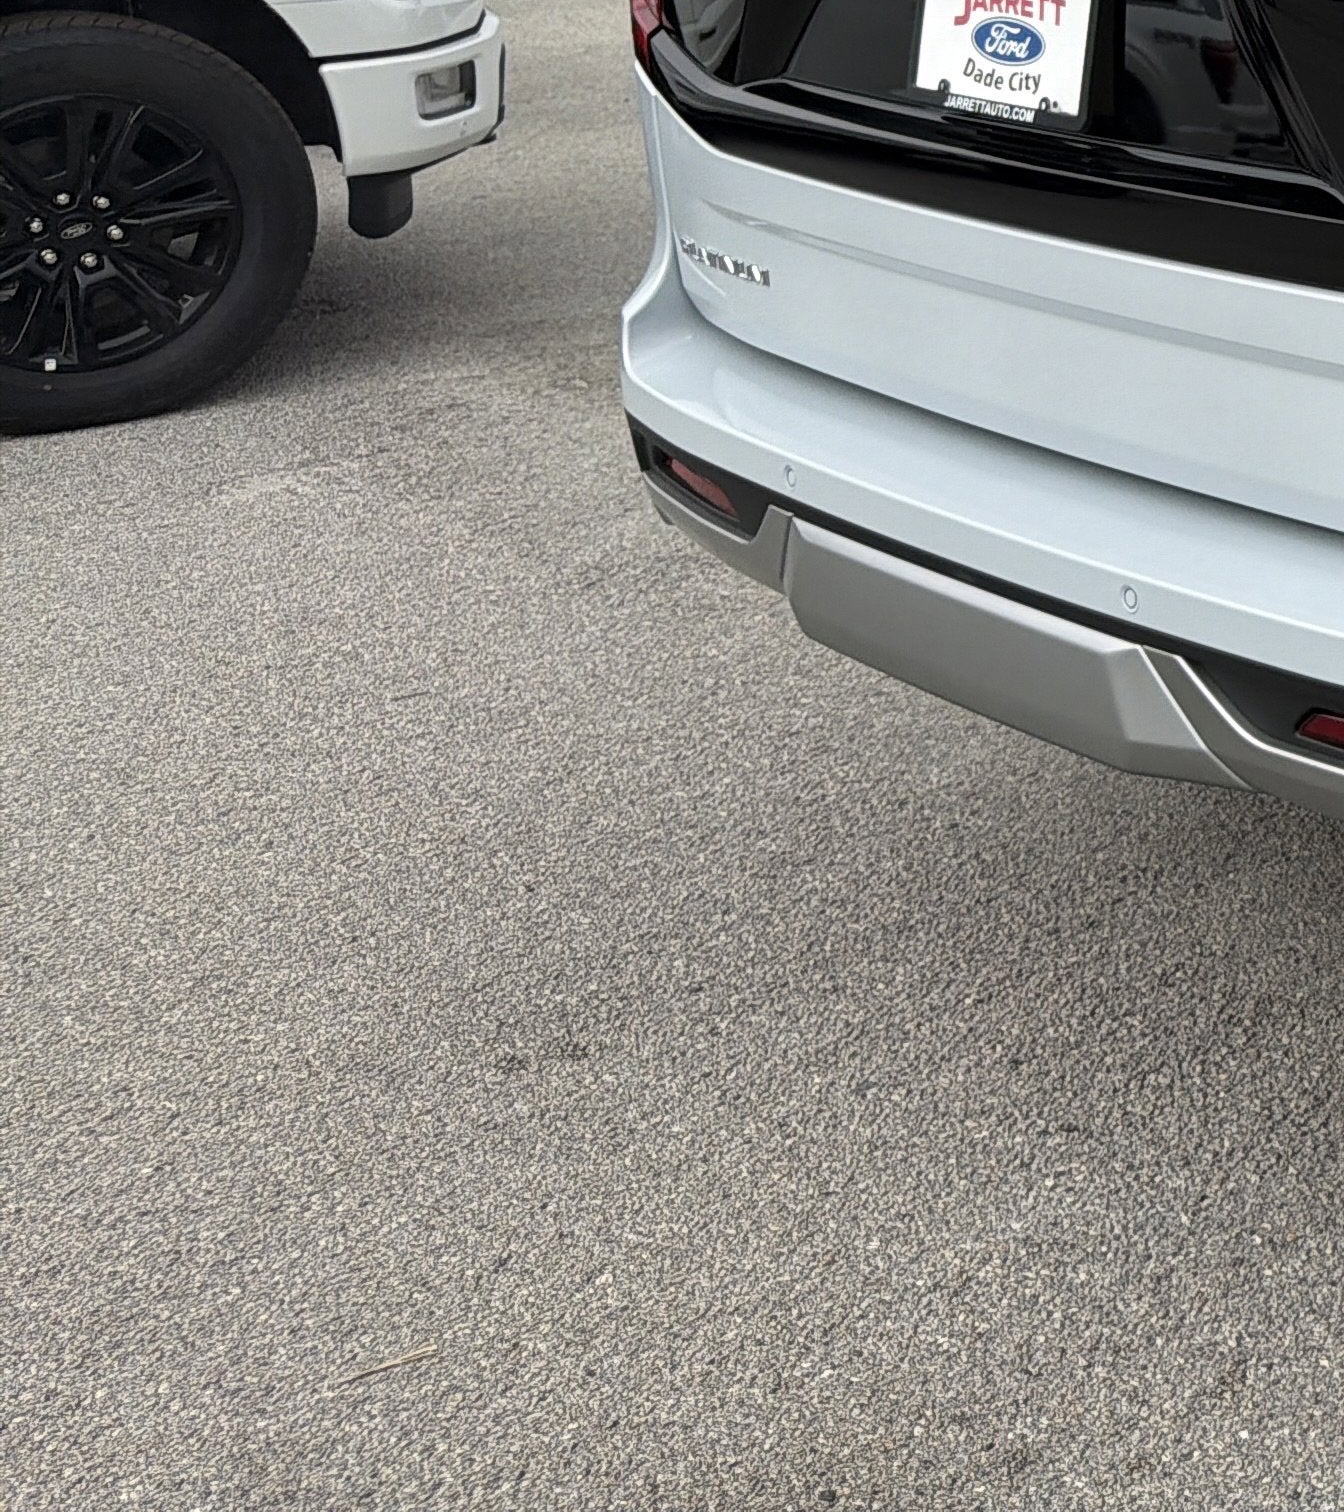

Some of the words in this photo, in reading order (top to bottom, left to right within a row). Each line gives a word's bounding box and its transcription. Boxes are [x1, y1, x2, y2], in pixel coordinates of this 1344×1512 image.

[984, 23, 1030, 59] Ford
[963, 58, 1004, 90] Dade
[1009, 71, 1041, 95] City
[944, 95, 1035, 123] JARRETTAUTO.COM
